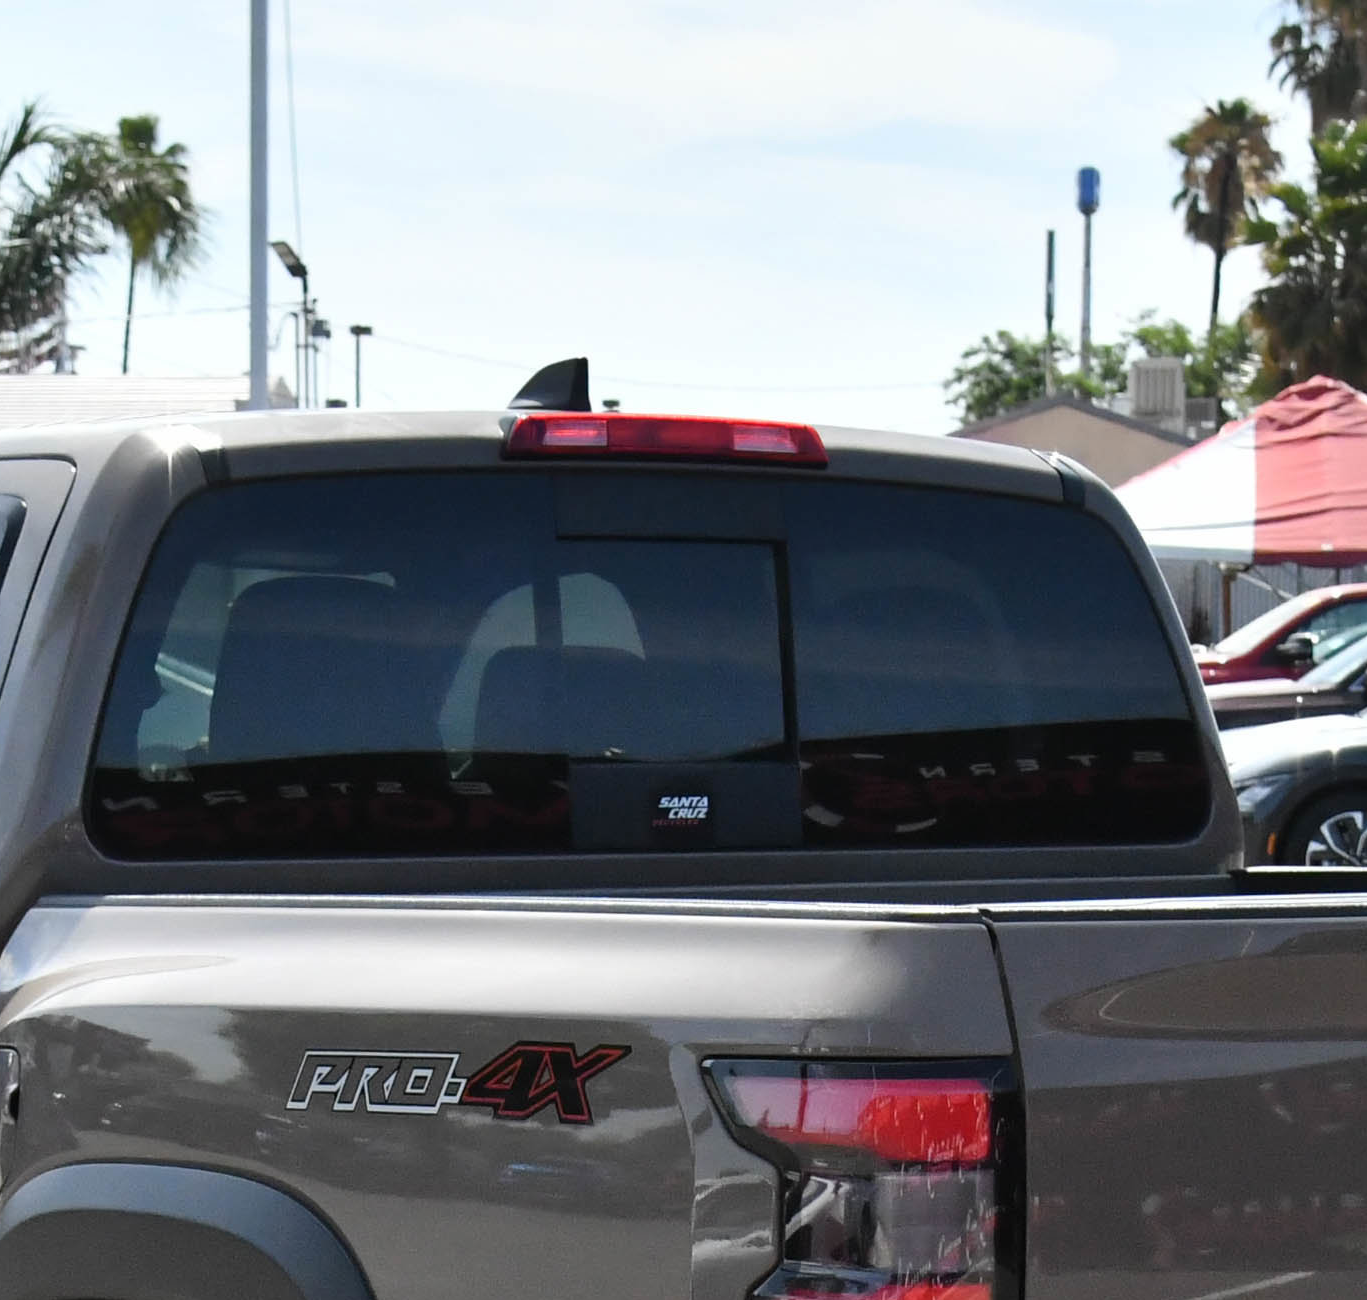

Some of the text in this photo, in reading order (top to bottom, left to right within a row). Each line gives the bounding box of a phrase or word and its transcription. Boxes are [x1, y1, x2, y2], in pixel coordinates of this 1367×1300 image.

[658, 796, 709, 808] SANTA
[668, 808, 708, 819] CRUZ
[285, 1041, 632, 1125] PRO-4X
